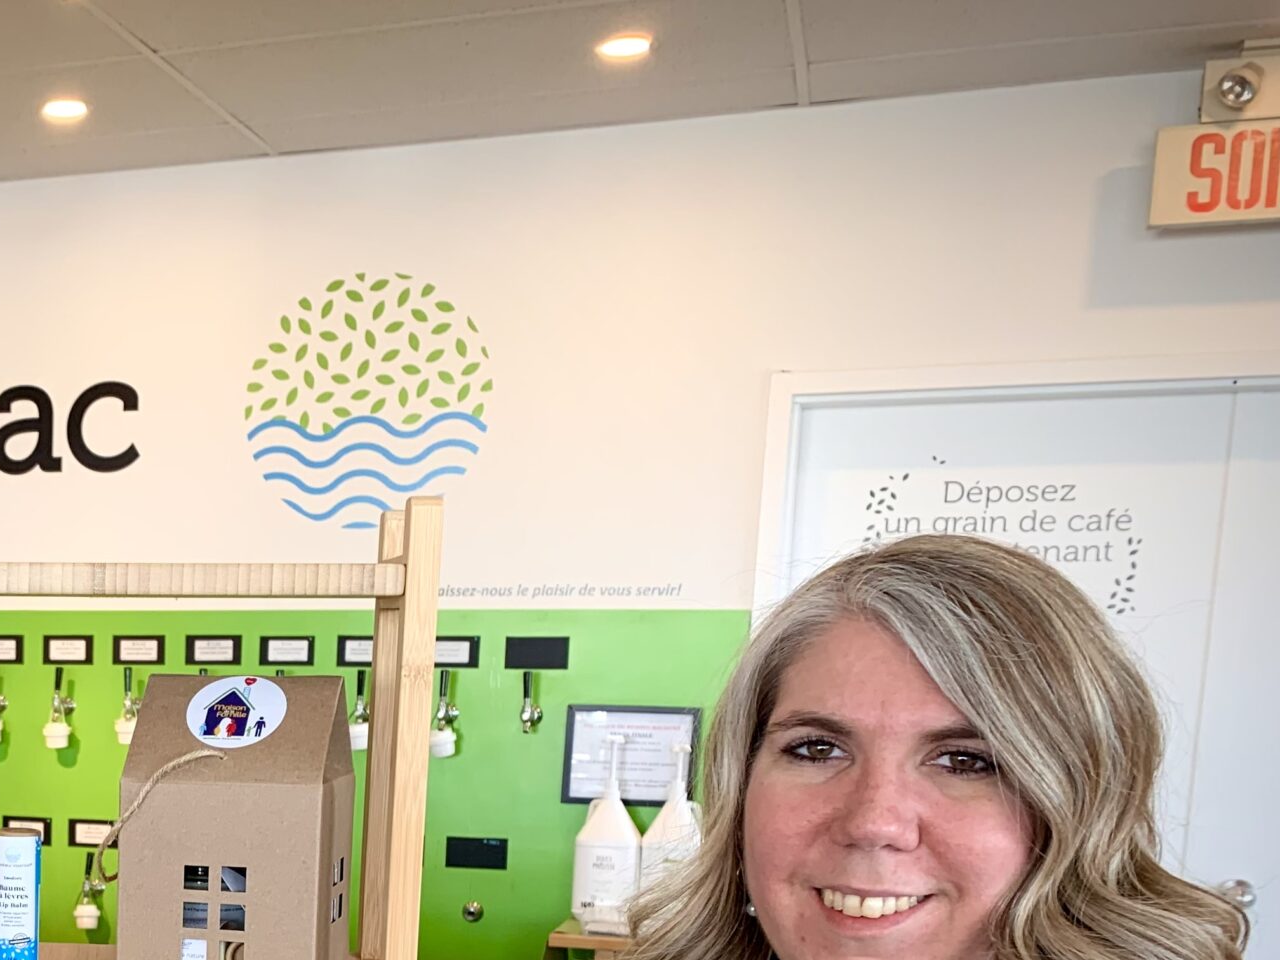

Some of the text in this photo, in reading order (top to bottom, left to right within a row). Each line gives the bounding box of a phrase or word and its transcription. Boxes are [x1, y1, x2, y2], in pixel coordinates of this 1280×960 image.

[943, 480, 1077, 508] Déposez
[884, 516, 921, 534] un
[1019, 509, 1057, 533] de
[1067, 508, 1133, 532] café
[438, 584, 683, 598] aissez-nous le plaisir de vous servir!
